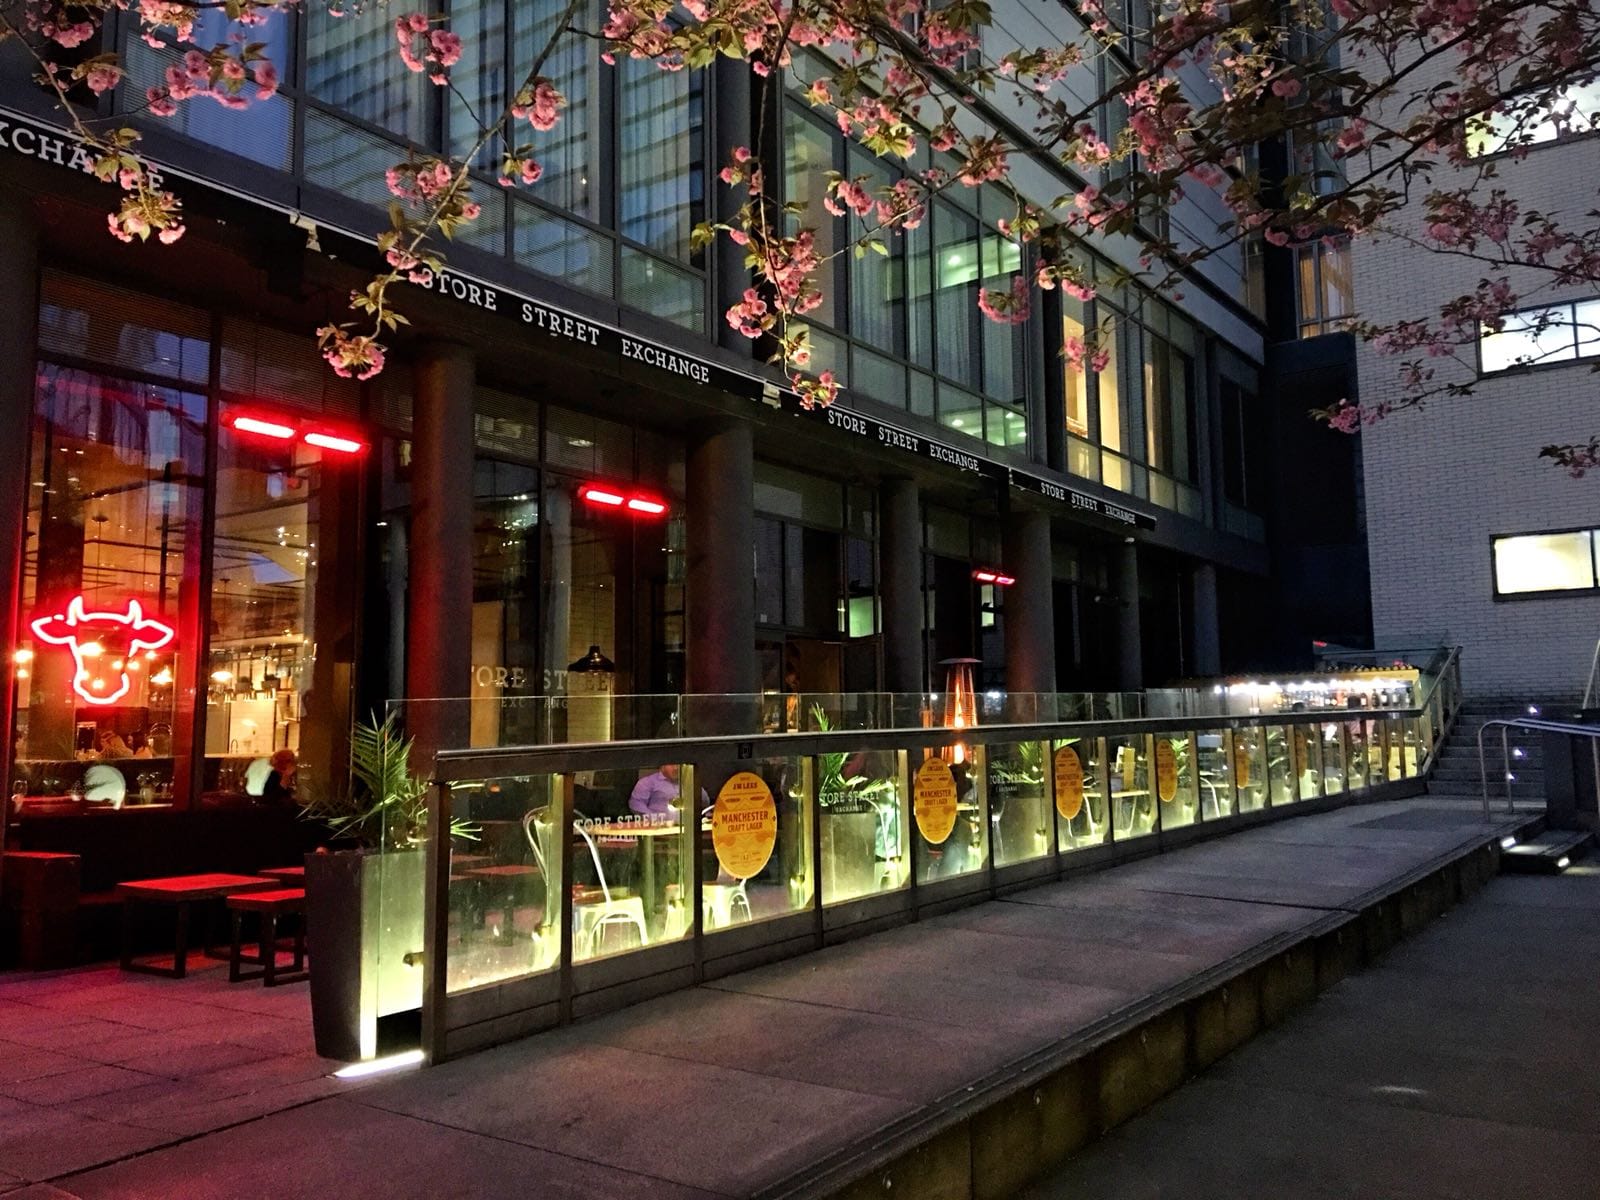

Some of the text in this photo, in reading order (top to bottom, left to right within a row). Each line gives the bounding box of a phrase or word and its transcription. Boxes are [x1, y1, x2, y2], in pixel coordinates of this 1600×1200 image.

[0, 121, 164, 197] CHAE
[421, 267, 710, 384] STORE STREET EXCHANGE
[828, 410, 979, 471] STORE STREET EXCHANGE
[1041, 482, 1065, 500] STORE
[1071, 493, 1098, 511] STREET
[471, 665, 525, 688] ORE
[617, 812, 667, 829] STREET
[721, 810, 768, 825] MANCHESTER
[728, 821, 763, 833] CRAFT LAGER
